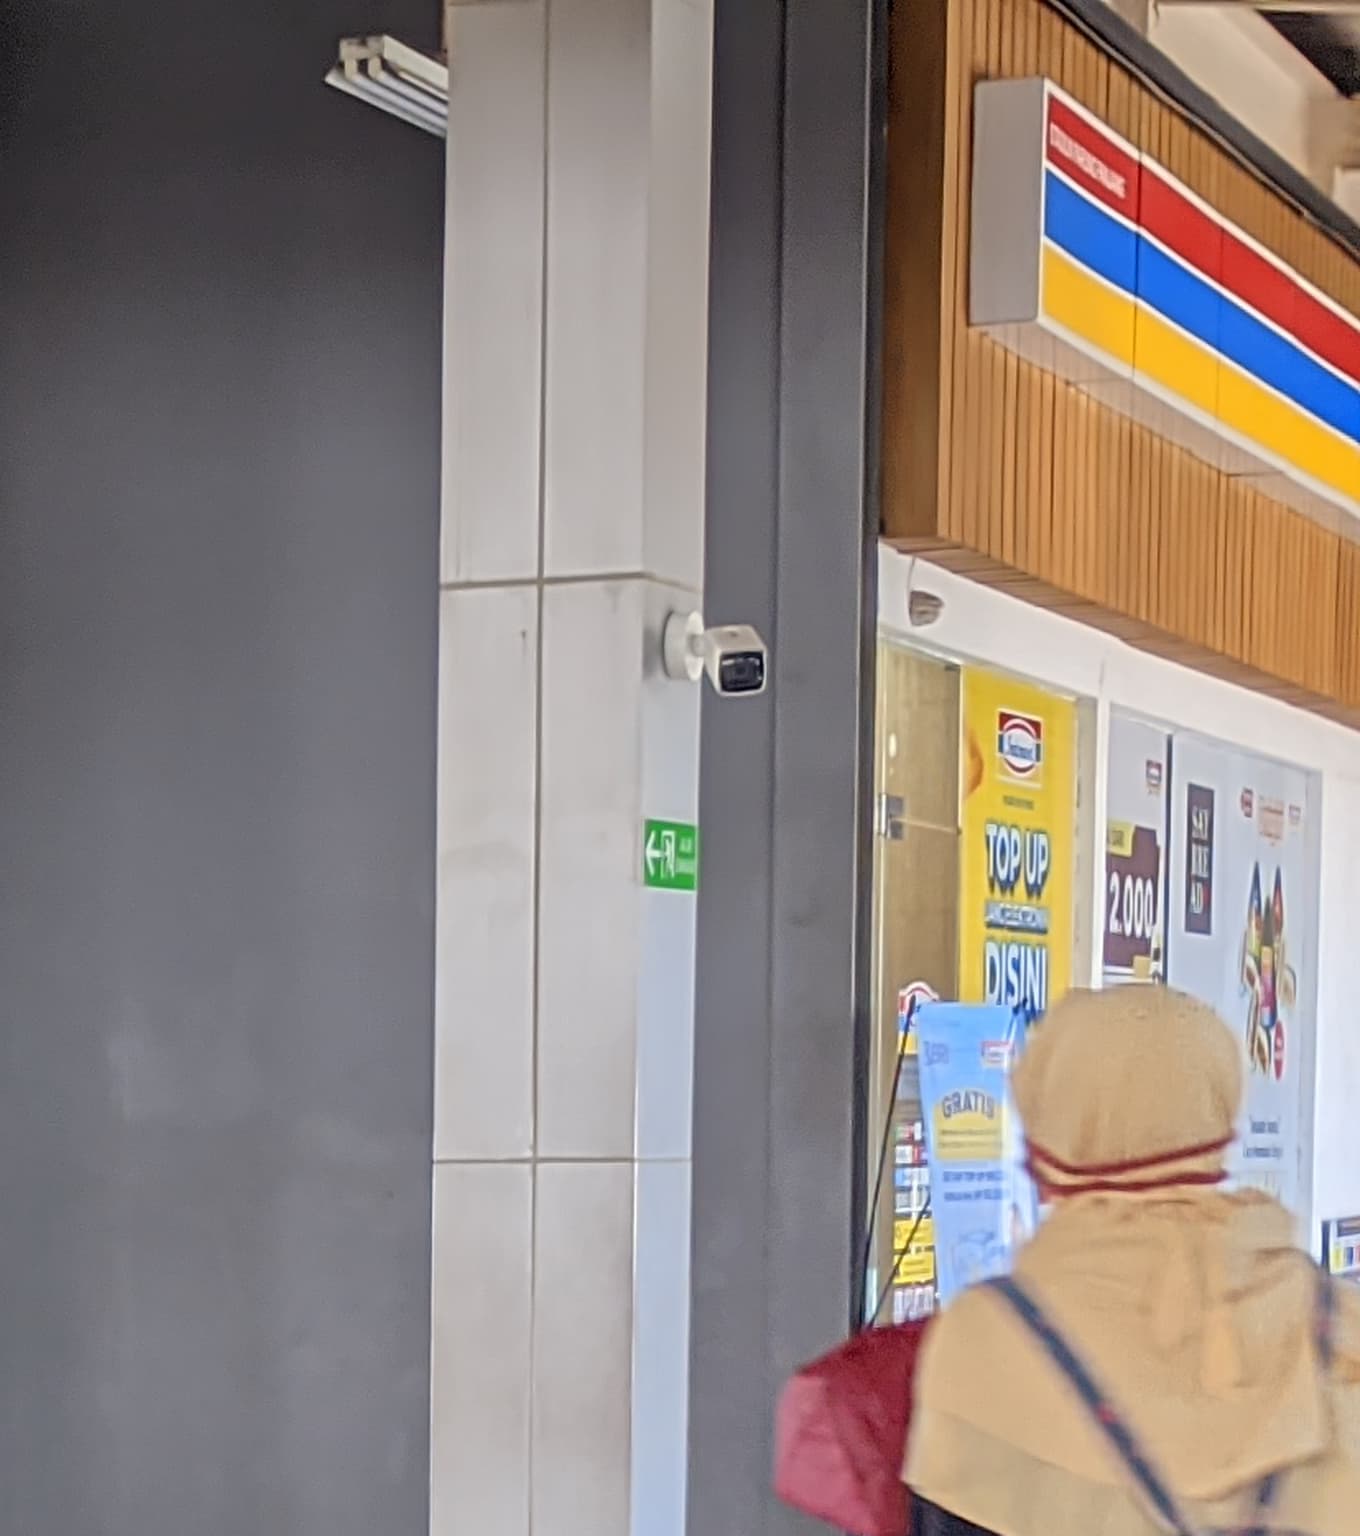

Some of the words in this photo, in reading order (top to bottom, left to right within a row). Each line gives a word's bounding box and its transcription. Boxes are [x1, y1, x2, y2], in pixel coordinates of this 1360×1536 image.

[985, 823, 1021, 884] TOP
[1026, 831, 1049, 886] UP
[985, 940, 1047, 1012] DISINI
